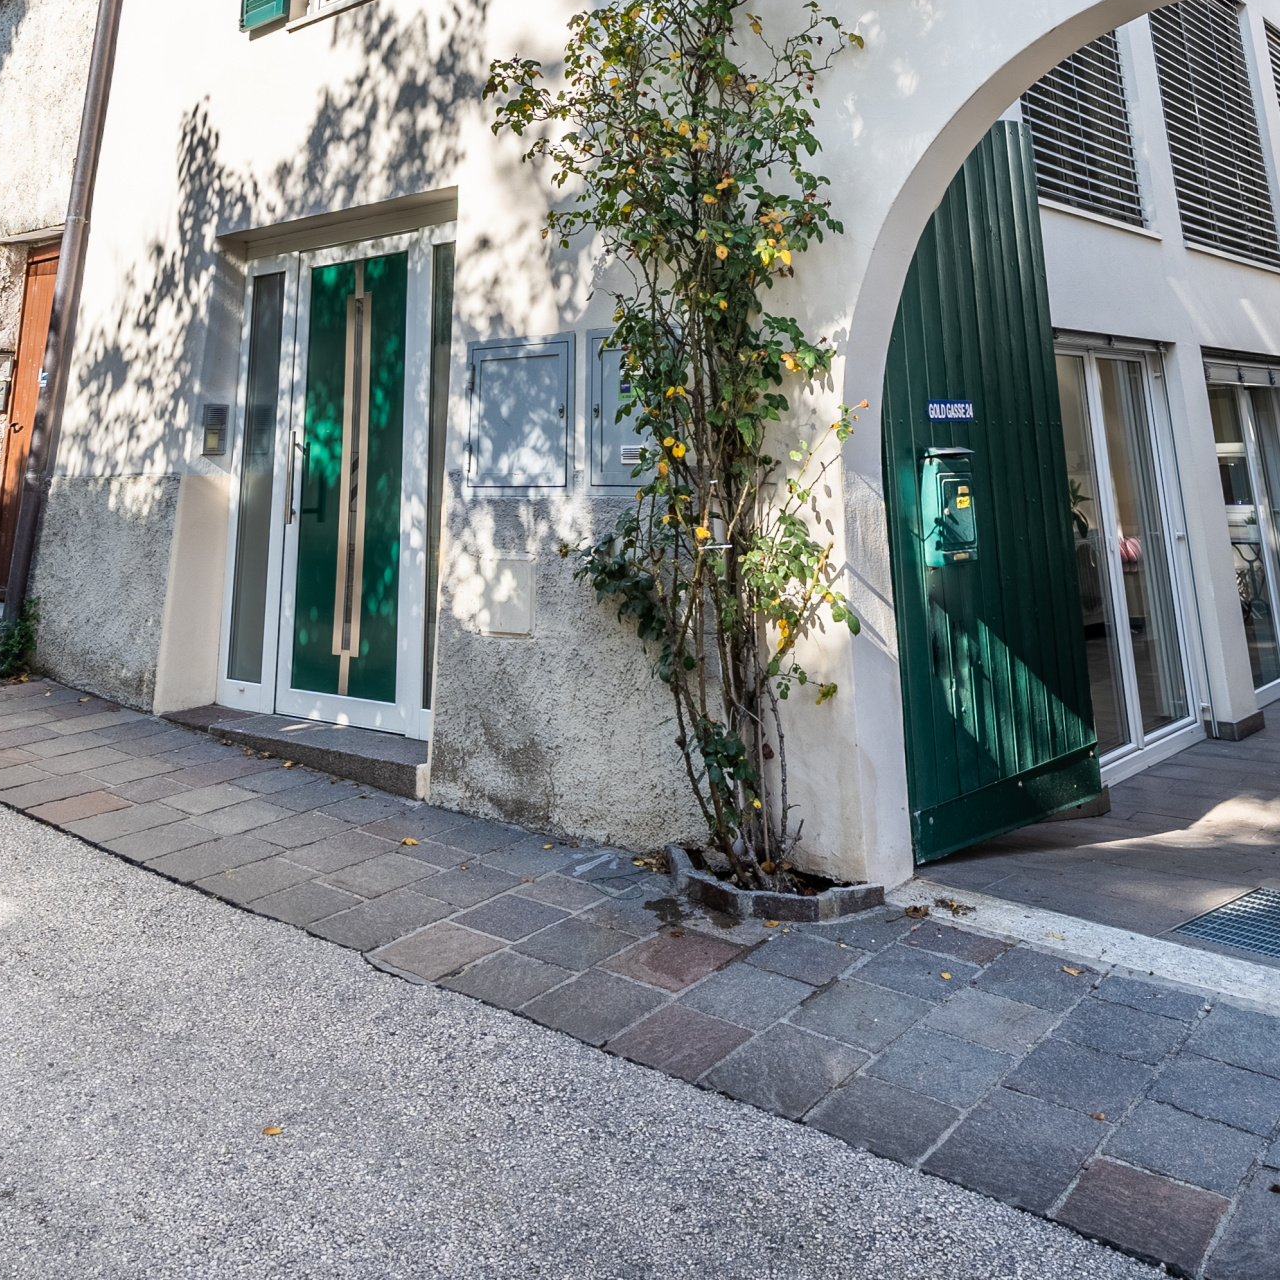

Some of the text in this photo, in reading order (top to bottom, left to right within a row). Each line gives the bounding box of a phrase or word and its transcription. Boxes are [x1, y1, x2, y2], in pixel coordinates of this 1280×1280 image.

[928, 403, 974, 419] GOLD GASSE 24
